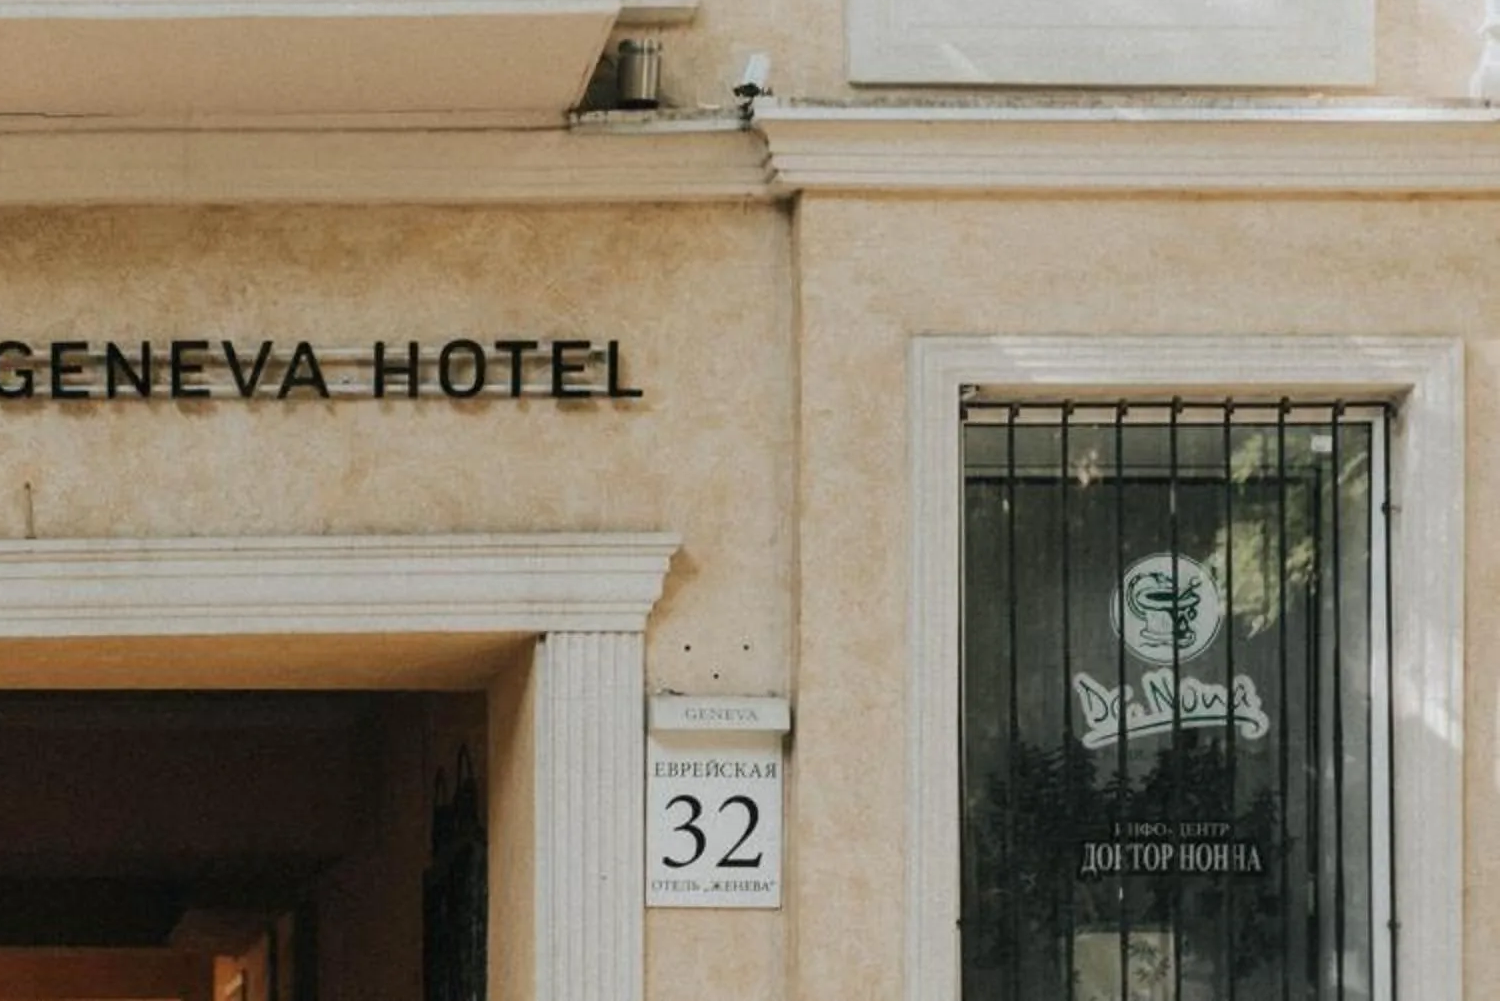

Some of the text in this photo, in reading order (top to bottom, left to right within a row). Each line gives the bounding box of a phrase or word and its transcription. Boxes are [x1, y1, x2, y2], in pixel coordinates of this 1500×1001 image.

[373, 338, 644, 400] HOTEL
[684, 706, 760, 722] GENEVA
[654, 758, 778, 779] ЕВРЕЙСКАЯ
[662, 794, 764, 869] 32
